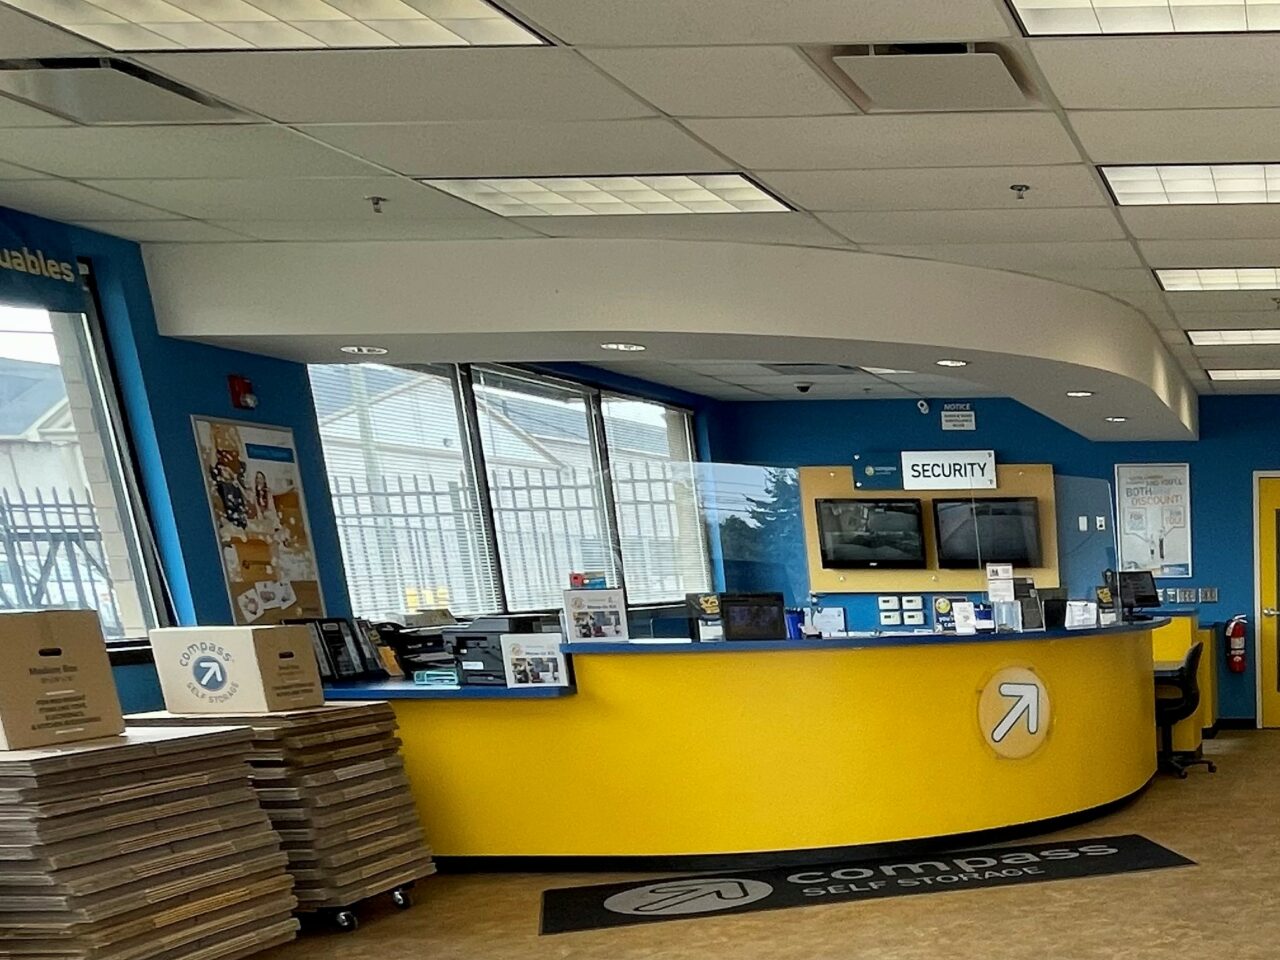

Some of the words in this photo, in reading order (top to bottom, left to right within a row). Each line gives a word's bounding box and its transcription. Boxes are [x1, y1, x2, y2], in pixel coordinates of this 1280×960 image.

[911, 463, 987, 478] SECURITY
[1126, 486, 1153, 498] BOTH
[179, 642, 232, 667] compass
[187, 681, 206, 699] SELF
[208, 680, 240, 703] STORAGE
[787, 844, 1119, 884] compass
[802, 879, 887, 897] SELF
[897, 865, 1046, 888] STORAGE
